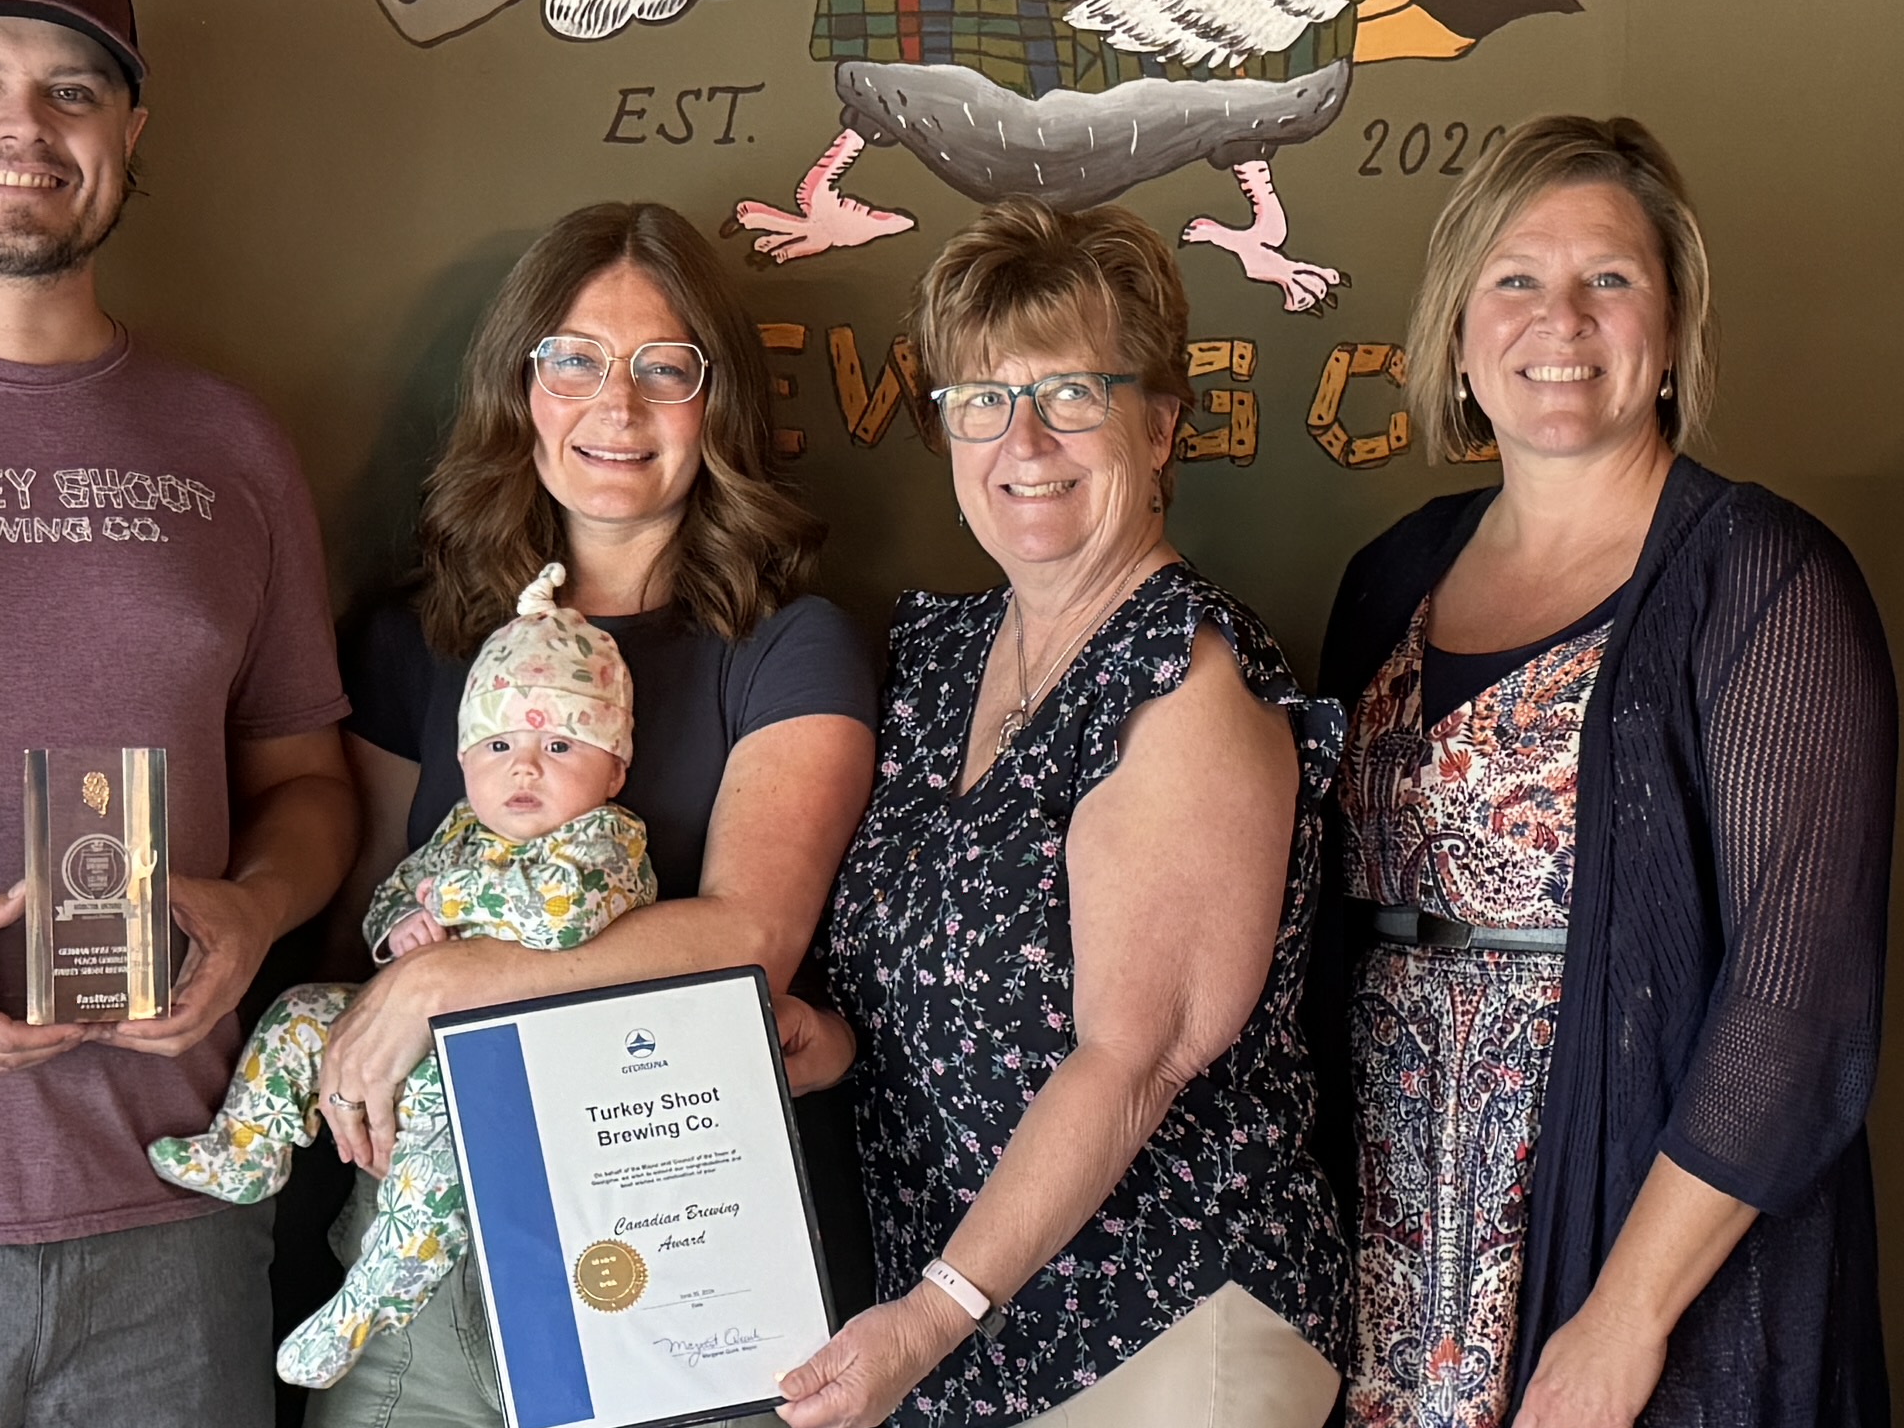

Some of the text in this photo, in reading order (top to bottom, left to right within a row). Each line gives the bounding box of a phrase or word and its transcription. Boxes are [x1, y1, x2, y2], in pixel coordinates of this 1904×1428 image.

[602, 83, 761, 147] EST.
[53, 468, 216, 521] SHOOT
[102, 516, 170, 543] CO.
[585, 1087, 720, 1122] Turkey Shoot
[597, 1115, 719, 1147] Brewing Co.
[614, 1202, 740, 1236] Canadian Brewing
[657, 1230, 706, 1252] Award
